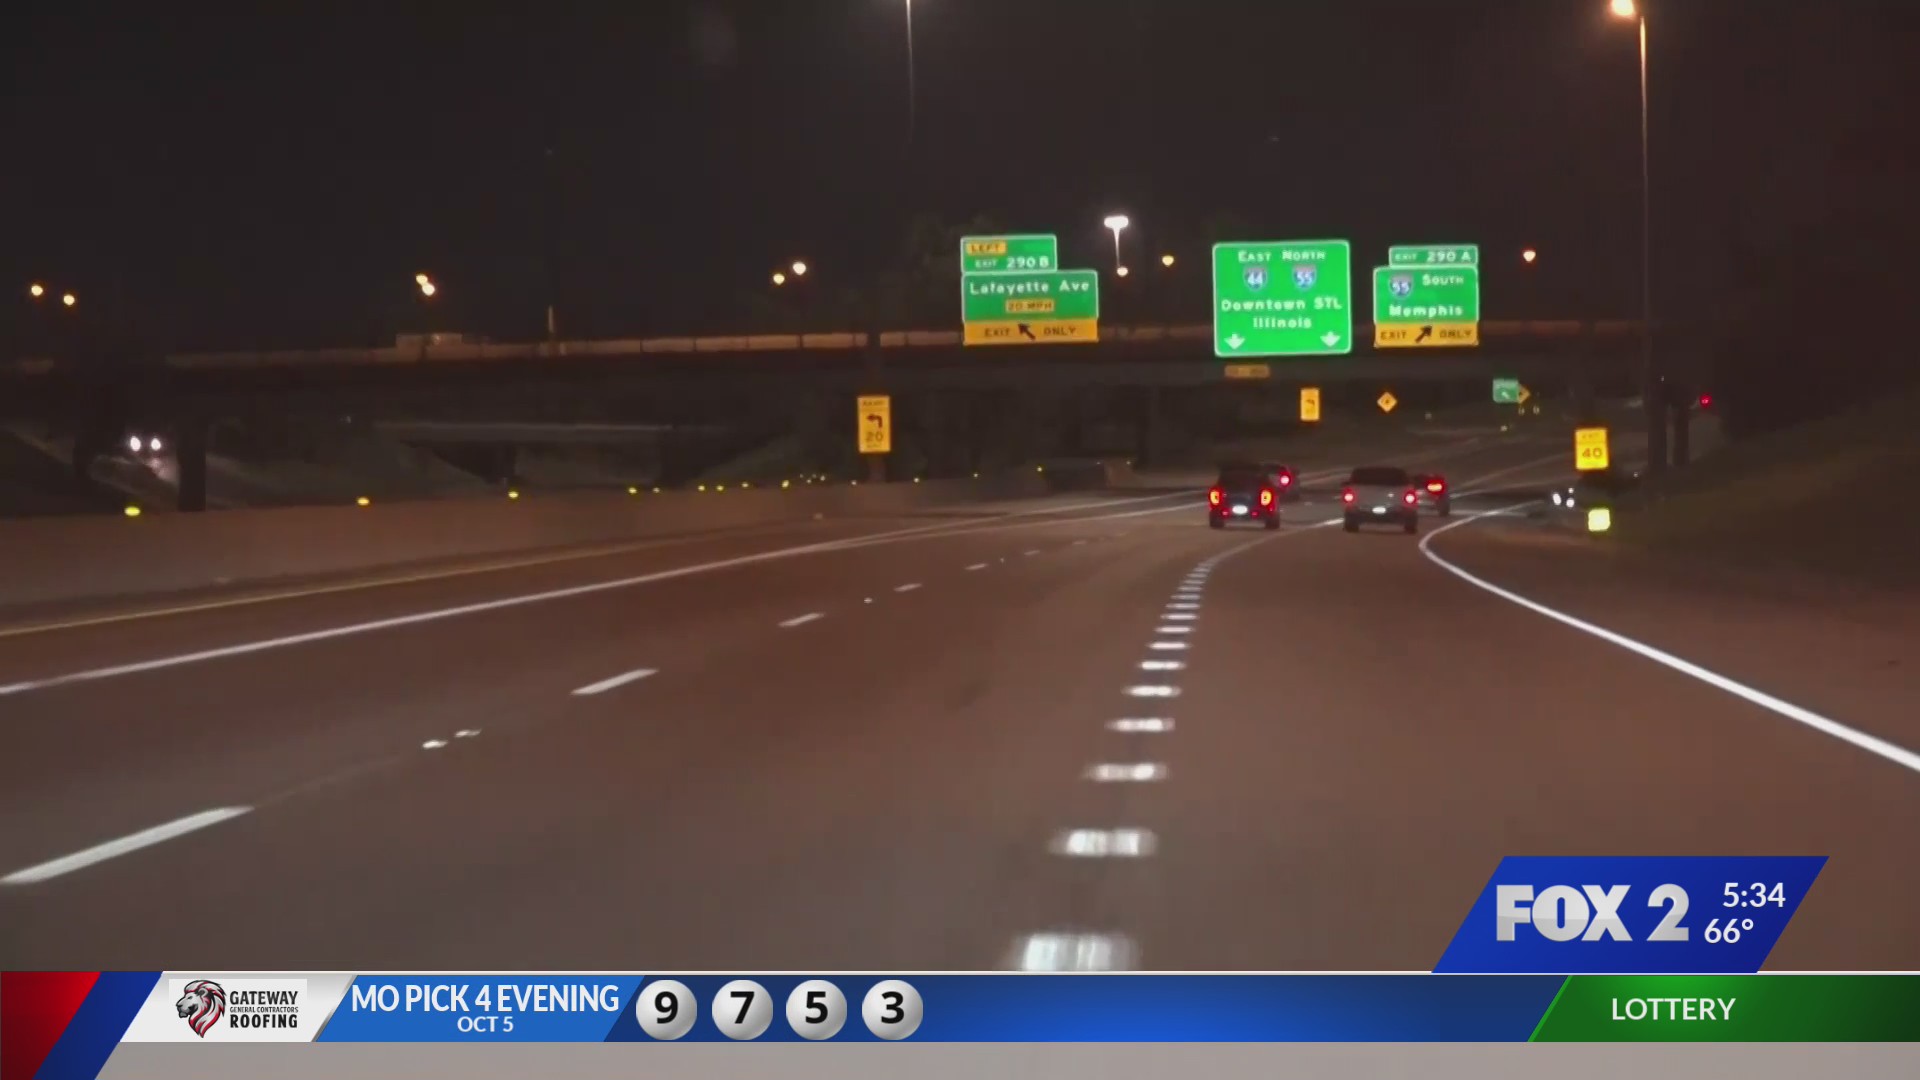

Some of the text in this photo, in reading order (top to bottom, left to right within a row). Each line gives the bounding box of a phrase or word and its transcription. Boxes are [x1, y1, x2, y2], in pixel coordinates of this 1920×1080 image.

[1238, 249, 1326, 262] EAST NORTH
[1427, 251, 1456, 262] 290
[1461, 251, 1472, 262] A
[1006, 256, 1036, 269] 290
[1247, 271, 1263, 285] 44
[1296, 271, 1313, 285] 55
[970, 279, 1090, 295] Lafayette Ave
[1391, 281, 1410, 294] 55
[1221, 296, 1343, 311] Downtown STL
[1388, 304, 1463, 318] Memphis
[1253, 316, 1312, 329] Illinois
[984, 326, 1077, 337] EXIT ONLY
[1380, 329, 1472, 340] EXIT ONLY
[865, 431, 884, 443] 20
[1582, 447, 1603, 459] 40
